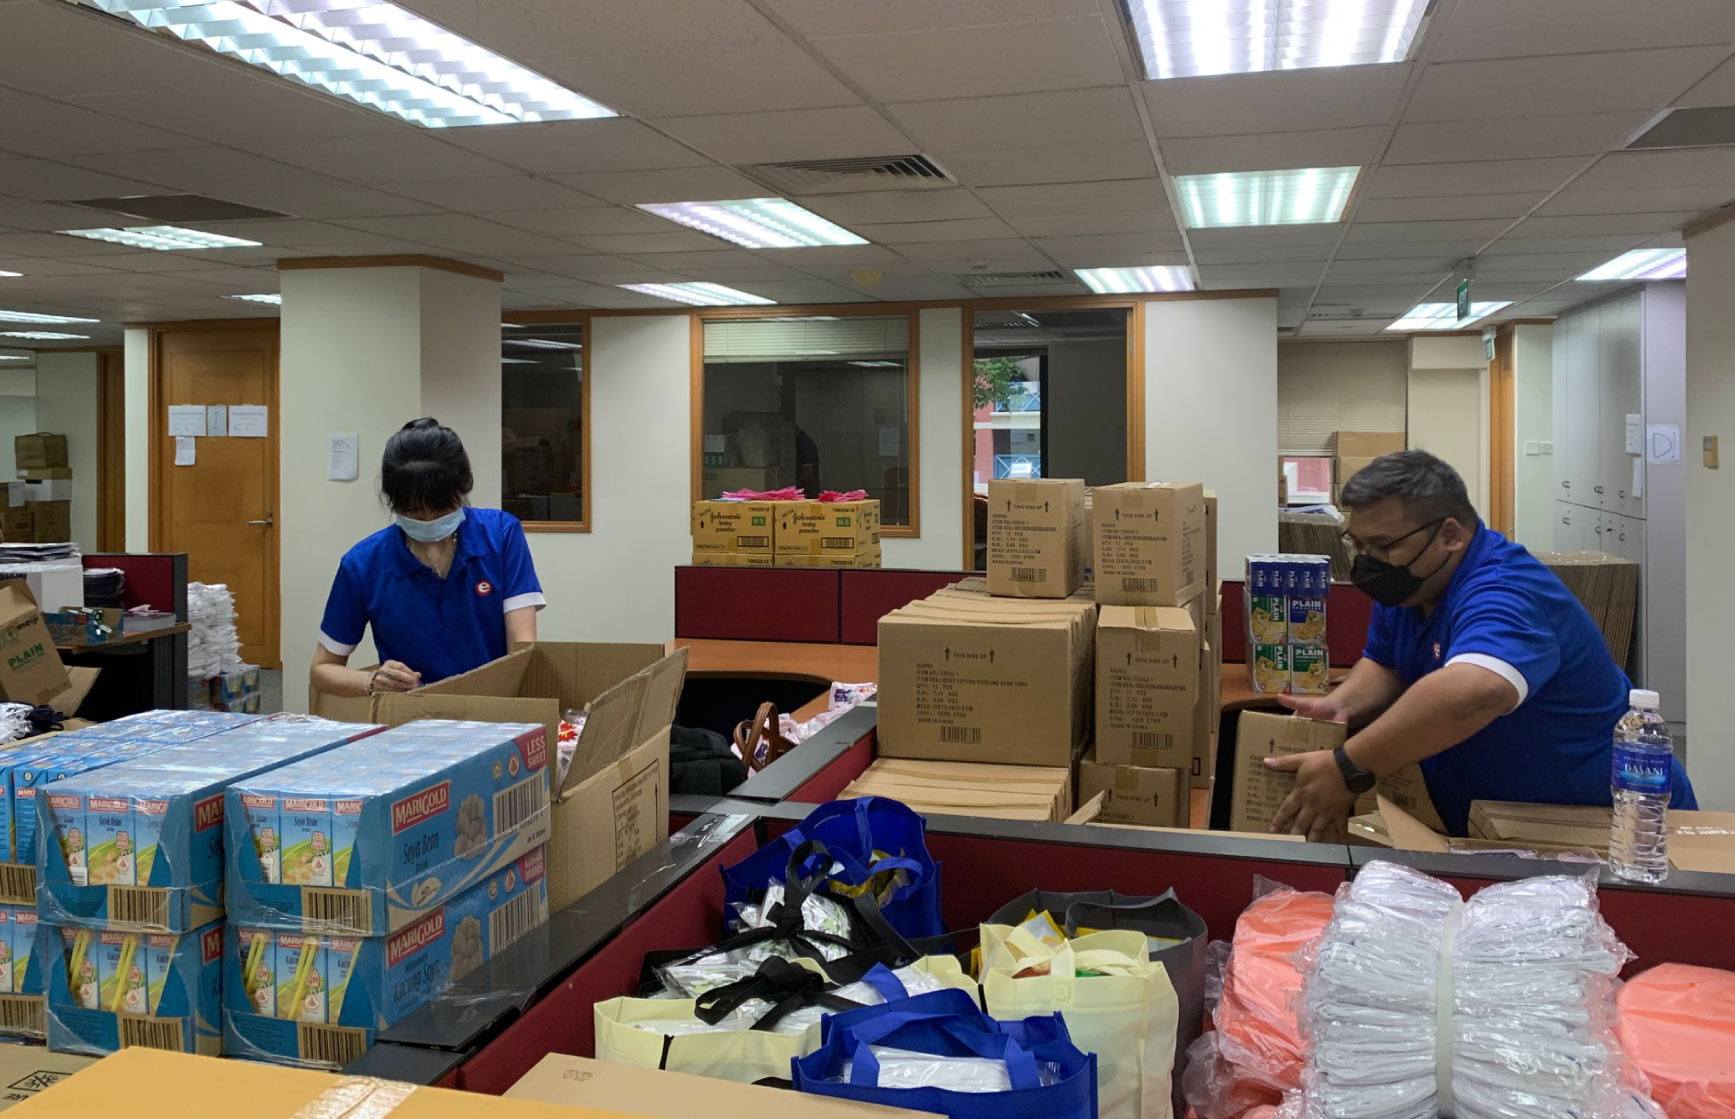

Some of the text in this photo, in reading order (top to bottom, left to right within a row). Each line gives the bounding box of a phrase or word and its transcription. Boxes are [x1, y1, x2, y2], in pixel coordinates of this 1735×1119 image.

[8, 642, 44, 668] PLAIN
[526, 735, 546, 756] LESS
[528, 752, 546, 768] SWEET
[1624, 763, 1664, 776] DASANI
[89, 799, 128, 812] MARIGOLD
[285, 800, 326, 811] MARIGOLD
[395, 788, 447, 828] MARIGOLD
[403, 832, 440, 865] Soya Bean
[390, 915, 442, 962] MARIGOLD
